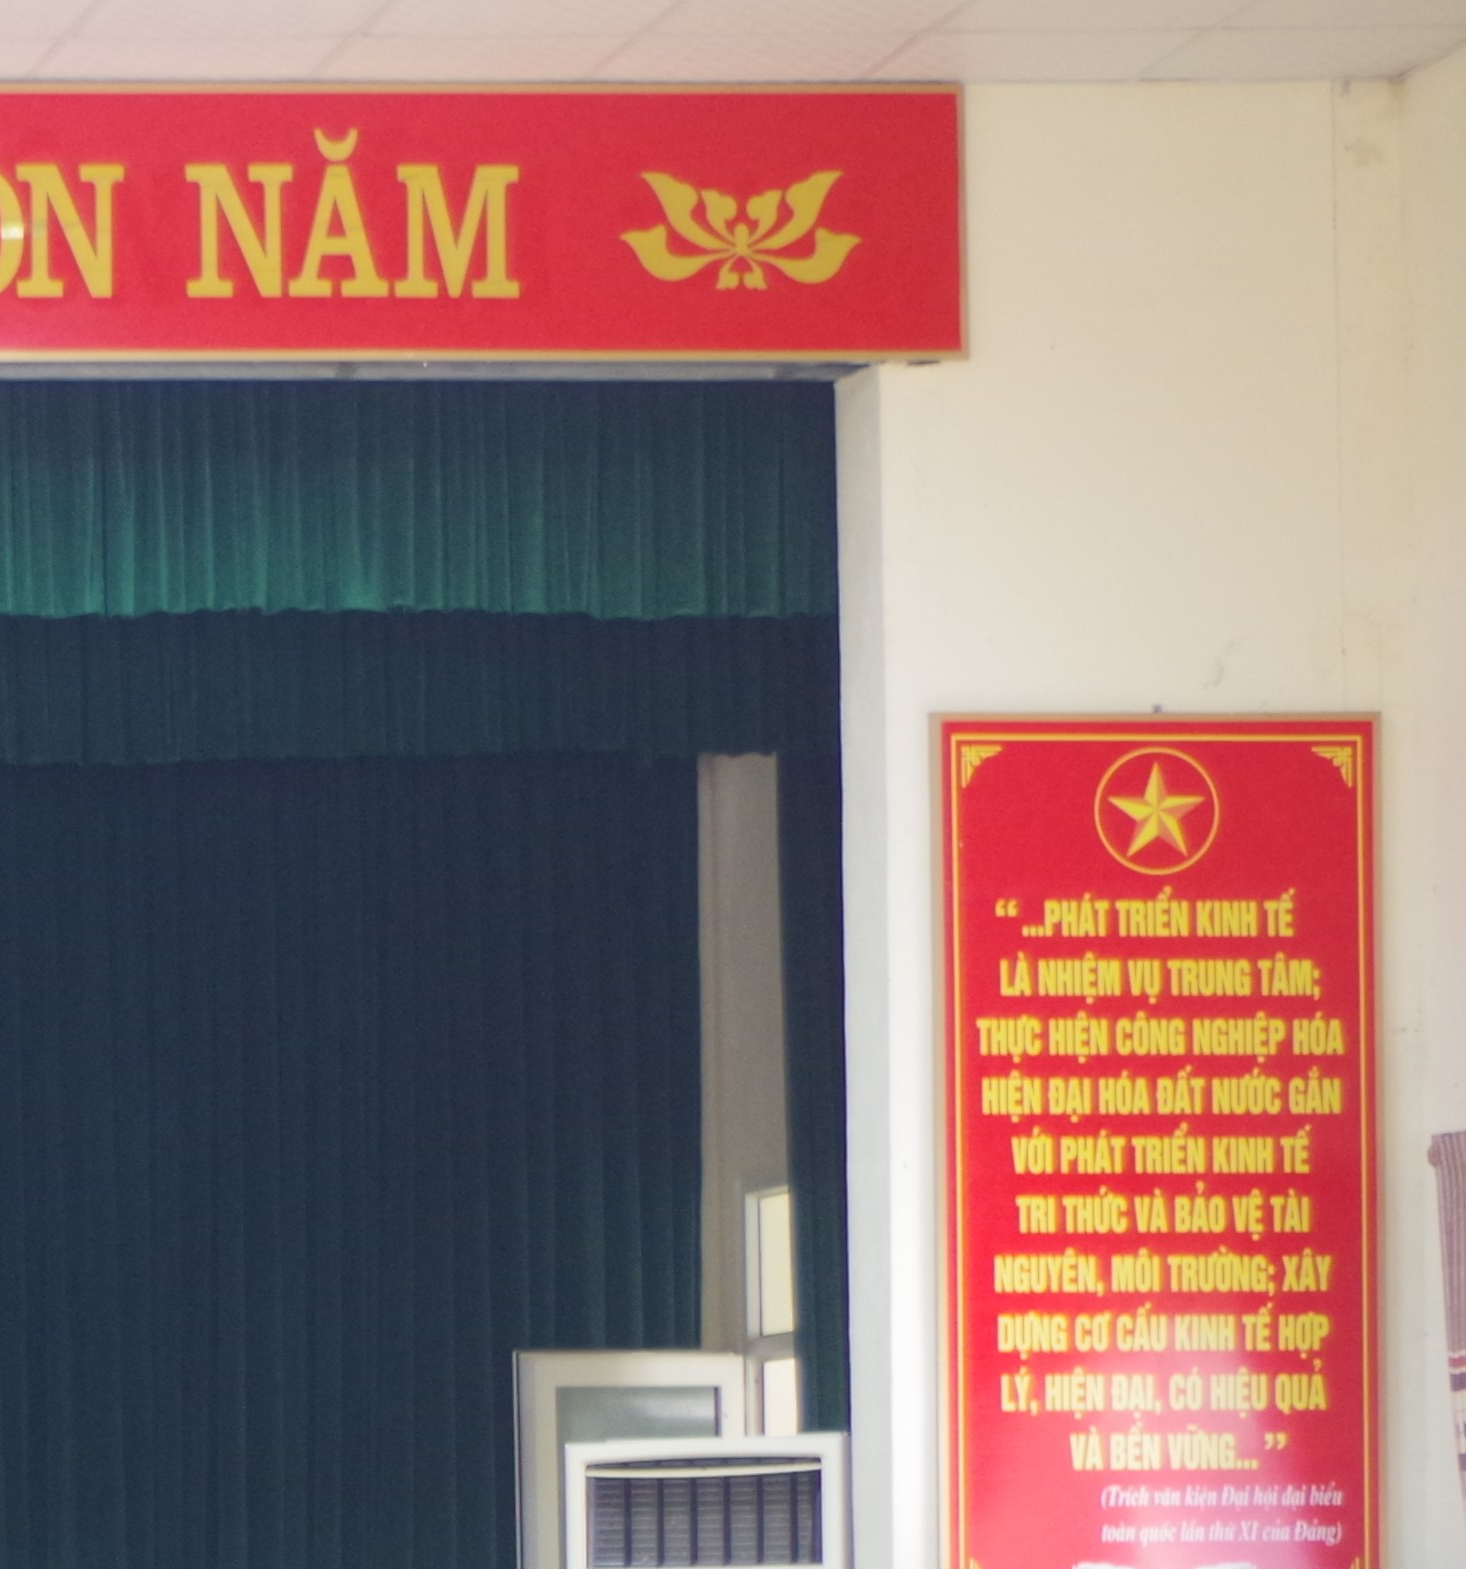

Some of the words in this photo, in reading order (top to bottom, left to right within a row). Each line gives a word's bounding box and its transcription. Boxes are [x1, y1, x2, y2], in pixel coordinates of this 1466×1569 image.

[185, 126, 521, 302] NĂM
[1115, 885, 1189, 938] TRIỂN
[1196, 899, 1257, 938] KINH
[1264, 888, 1296, 938] TẾ
[999, 951, 1031, 997] LÀ
[1038, 951, 1121, 1005] NHIỆM
[1127, 959, 1160, 1005] VỤ
[1168, 959, 1252, 997] TRUNG
[1258, 952, 1321, 1001] TÂM;
[976, 1014, 1042, 1064] THỰC
[1048, 1010, 1109, 1064] HIỆN
[1115, 1011, 1185, 1056] CÔNG
[1192, 1011, 1286, 1064] NGHIỆP
[1293, 1011, 1344, 1056] HÓA
[981, 1070, 1041, 1123] HIỆN
[1048, 1078, 1091, 1123] ĐẠI
[1099, 1070, 1151, 1116] HÓA
[1156, 1065, 1205, 1116] ĐẤT
[1211, 1067, 1283, 1116] NƯỚC
[1288, 1066, 1341, 1116] GẮN
[1011, 1126, 1053, 1175] VỚI
[1060, 1129, 1125, 1175] PHÁT
[1131, 1122, 1206, 1175] TRIỂN
[1212, 1135, 1274, 1175] KINH
[1280, 1124, 1311, 1175] TẾ
[1016, 1195, 1056, 1234] TRI
[1062, 1186, 1128, 1234] THỨC
[1135, 1188, 1168, 1234] VÀ
[1174, 1181, 1226, 1234] BẢO
[1232, 1188, 1265, 1242] VỆ
[1270, 1188, 1311, 1234] TÀI
[994, 1248, 1105, 1297] NGUYÊN,
[1111, 1248, 1161, 1294] MÔI
[1168, 1246, 1275, 1297] TRƯỜNG;
[1282, 1248, 1332, 1294] XÂY
[997, 1309, 1068, 1360] DỰNG
[1074, 1311, 1111, 1352] CƠ
[1116, 1302, 1168, 1352] CẤU
[1174, 1315, 1235, 1352] KINH
[1242, 1302, 1274, 1352] TẾ
[1278, 1311, 1330, 1359] HỢP
[1001, 1367, 1038, 1416] LÝ,
[1045, 1367, 1105, 1419] HIỆN
[1111, 1373, 1162, 1419] ĐẠI,
[1169, 1366, 1203, 1411] CÓ
[1209, 1366, 1268, 1419] HIỆU
[1275, 1359, 1327, 1412] QUẢ
[1071, 1426, 1103, 1471] VÀ
[1110, 1423, 1162, 1471] BỀN
[1100, 1485, 1149, 1510] (Trích
[1154, 1490, 1181, 1507] văn
[1185, 1487, 1217, 1511] kiện
[1220, 1487, 1249, 1511] Đại
[1253, 1486, 1278, 1510] hội
[1282, 1486, 1306, 1510] đại
[1310, 1481, 1343, 1507] biểu
[1101, 1523, 1136, 1543] toàn
[1140, 1518, 1177, 1548] quốc
[1181, 1518, 1205, 1543] lần
[1209, 1520, 1235, 1543] thứ
[1239, 1523, 1259, 1543] XI
[1262, 1521, 1290, 1543] của
[1293, 1519, 1343, 1546] Đảng)
